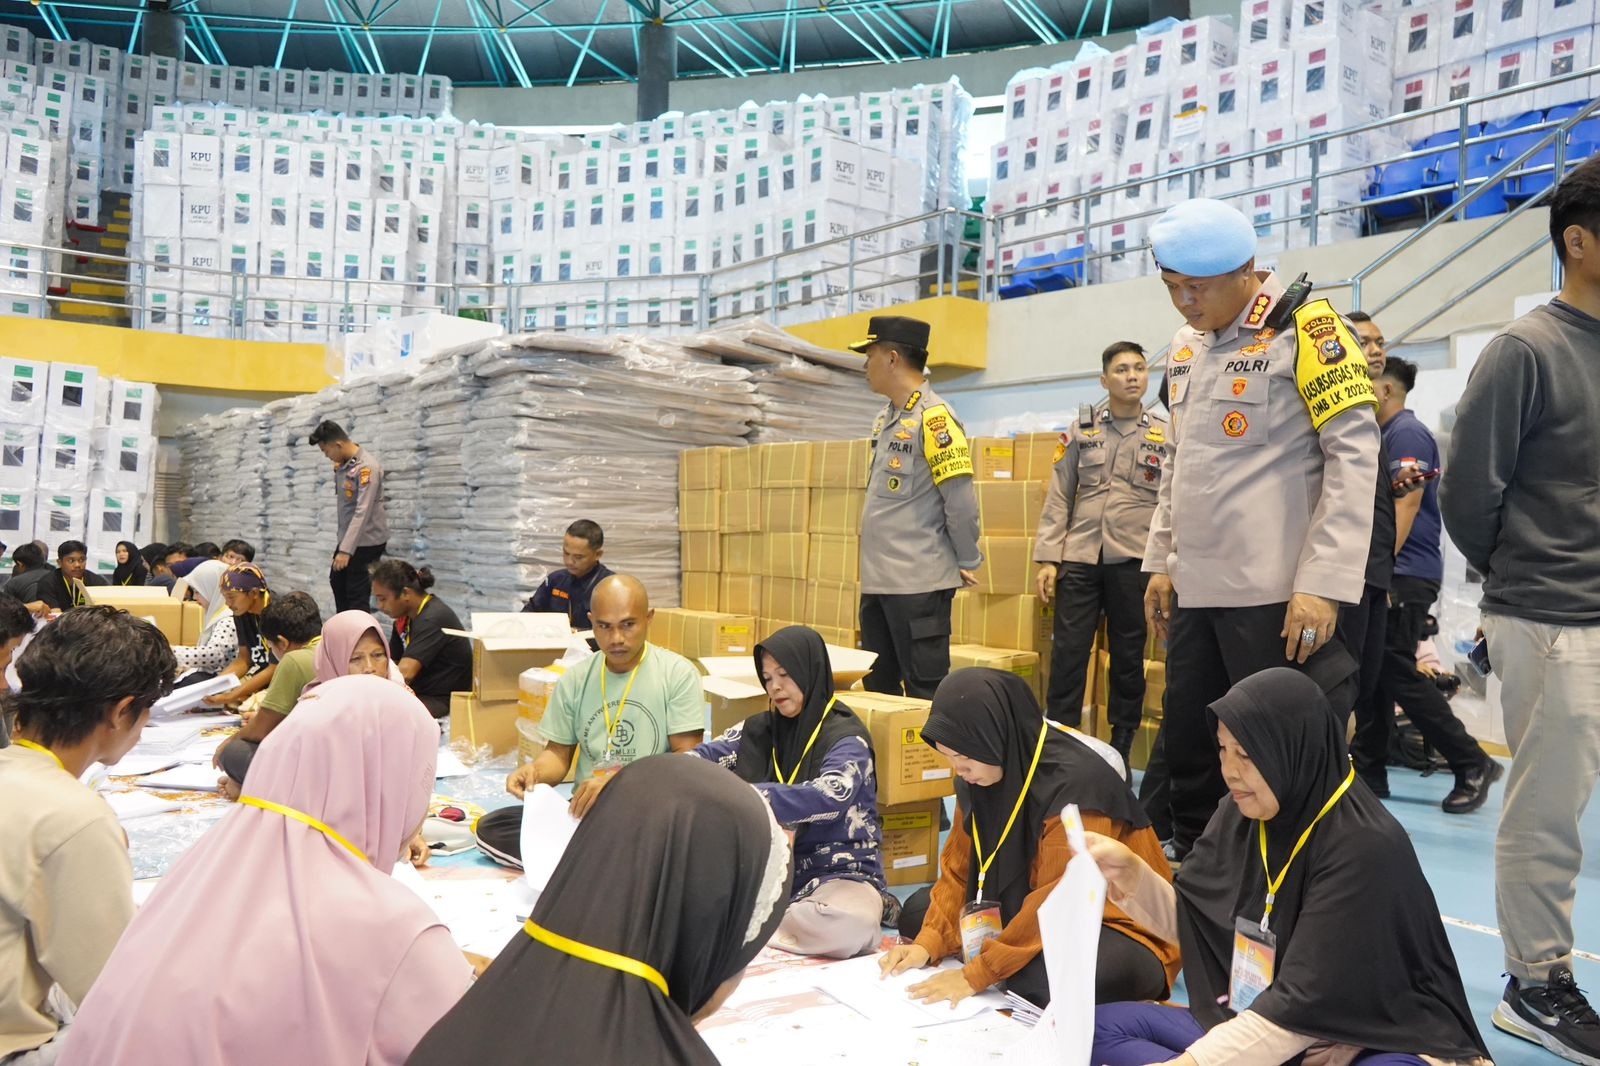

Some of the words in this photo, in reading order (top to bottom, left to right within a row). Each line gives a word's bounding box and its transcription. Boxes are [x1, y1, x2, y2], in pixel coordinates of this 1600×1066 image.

[190, 152, 212, 162] KPU
[835, 159, 855, 174] KPU
[866, 168, 885, 182] KPU
[190, 205, 211, 214] KPU
[829, 222, 848, 237] KPU
[192, 257, 213, 267] KPU
[1304, 317, 1334, 332] POLDA
[1313, 326, 1334, 337] RIAU
[1224, 360, 1270, 373] POLRI
[1302, 364, 1354, 401] KASUBSATGAS
[1312, 398, 1331, 418] OMB
[1330, 390, 1344, 406] LK
[888, 441, 913, 455] POLRI
[583, 726, 590, 738] ME
